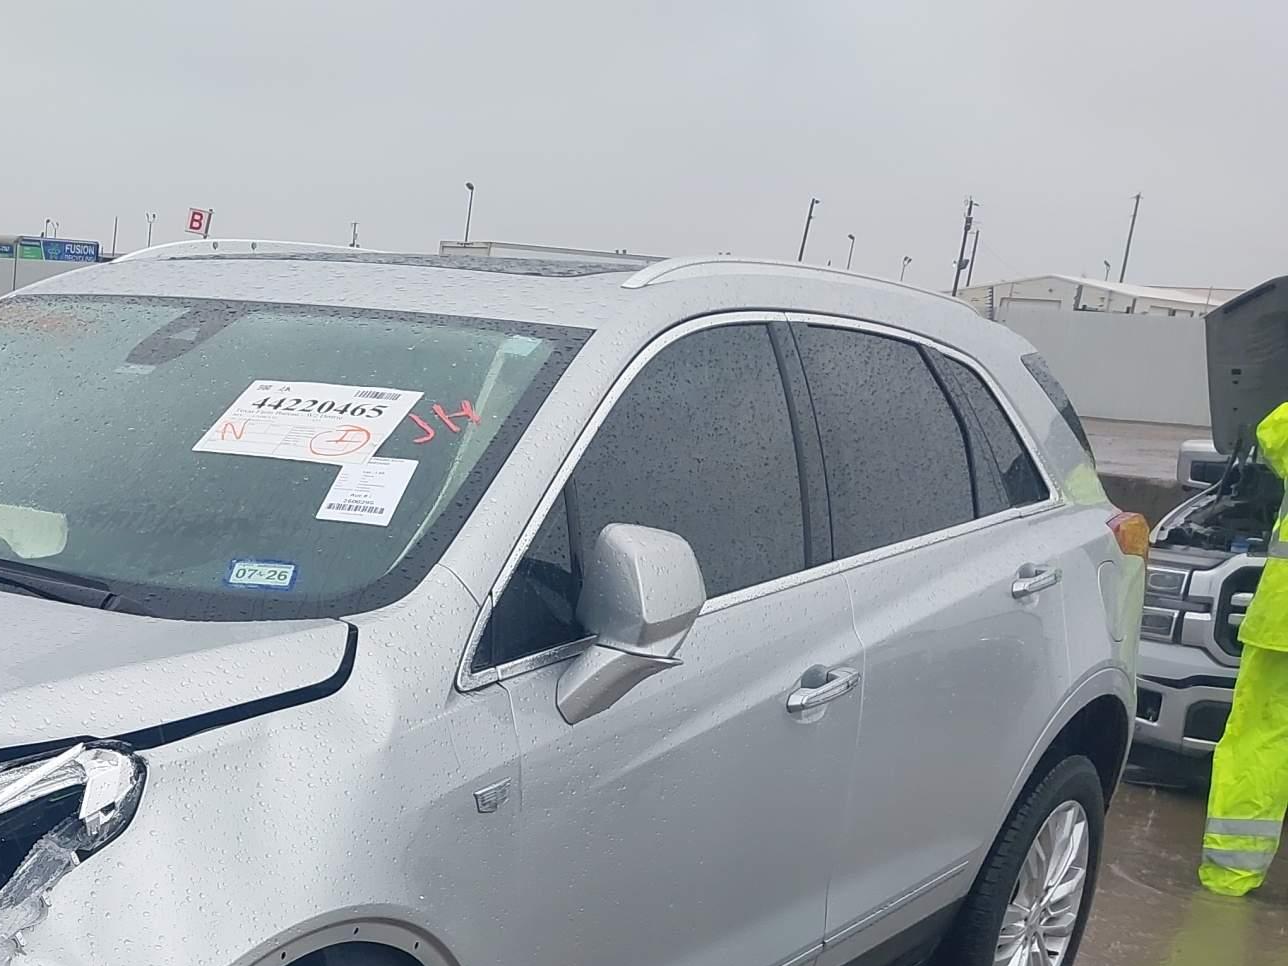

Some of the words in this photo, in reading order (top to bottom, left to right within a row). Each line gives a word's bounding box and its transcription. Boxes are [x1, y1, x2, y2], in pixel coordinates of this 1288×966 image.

[189, 211, 204, 231] B
[65, 244, 95, 256] FUSION
[252, 396, 389, 419] 44220465
